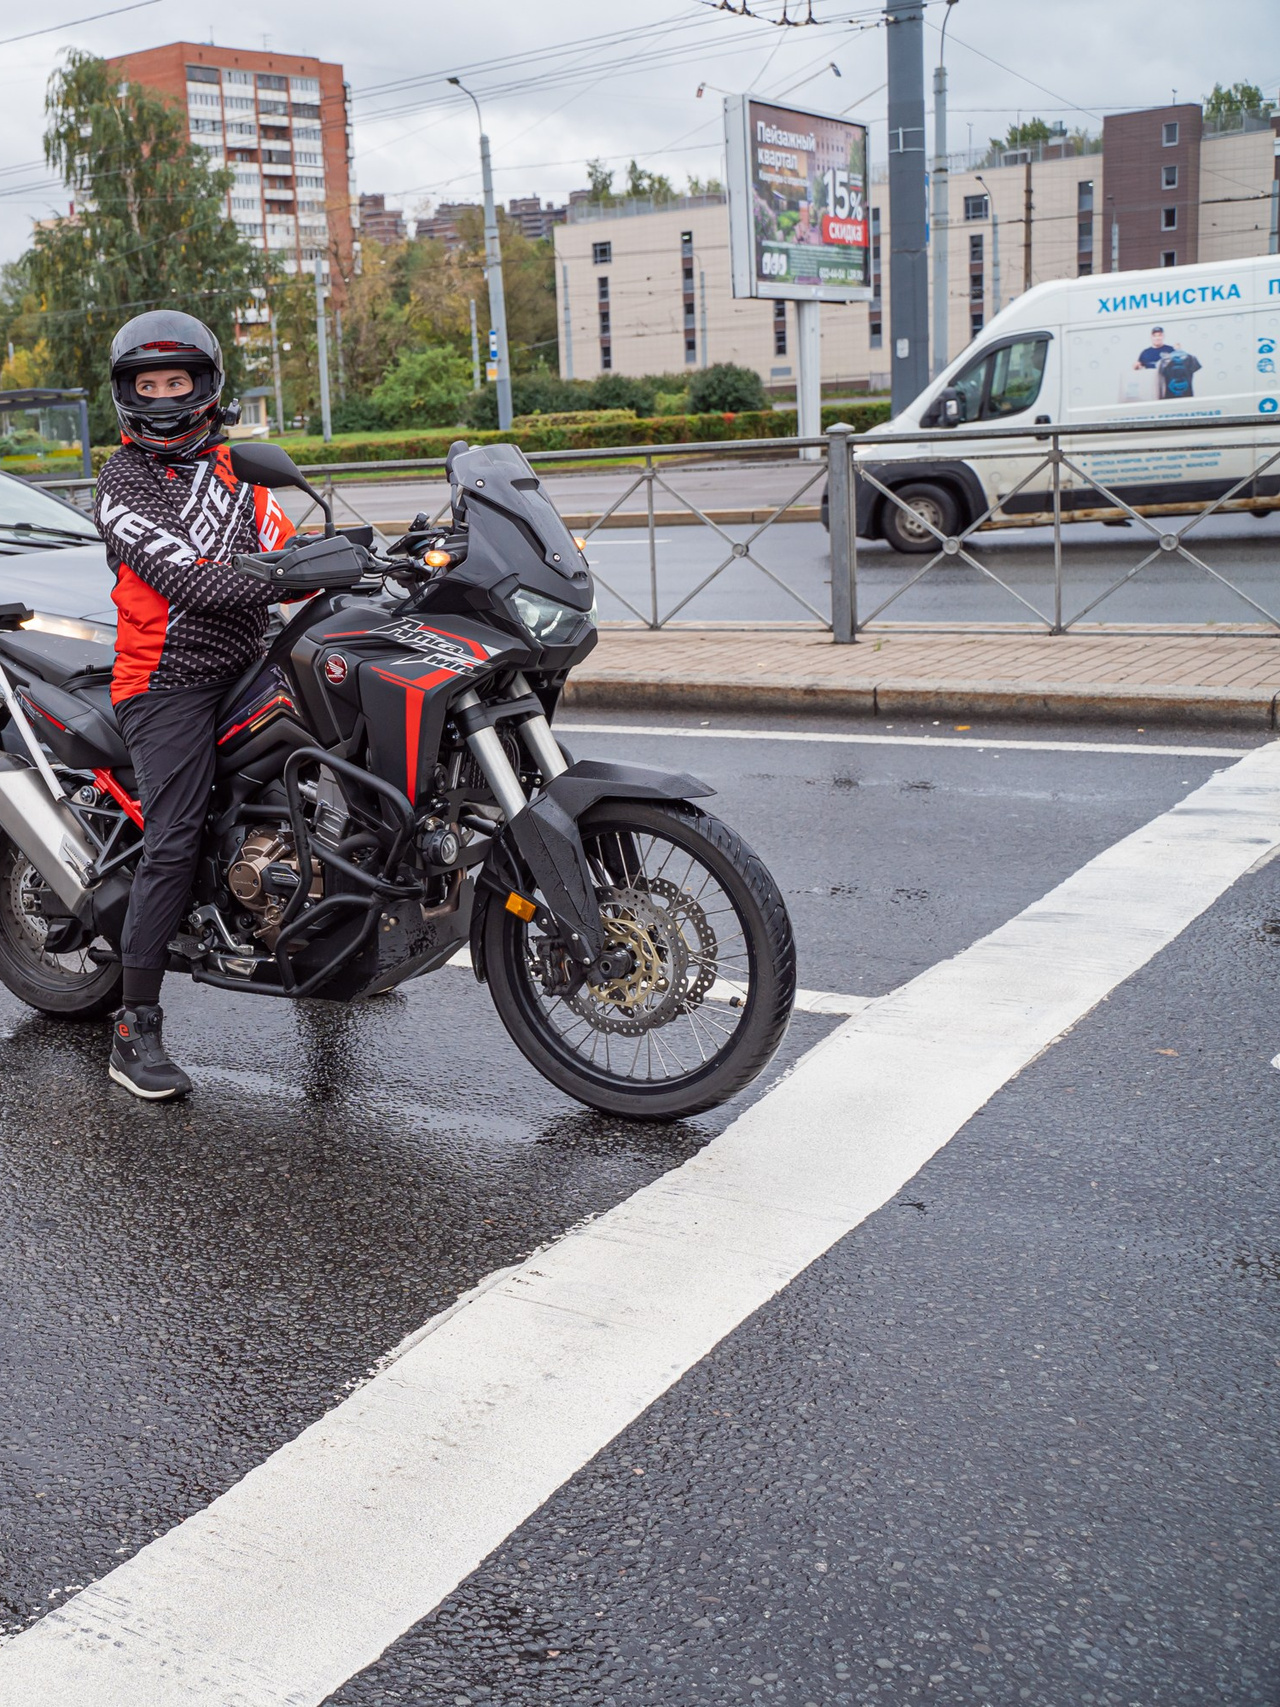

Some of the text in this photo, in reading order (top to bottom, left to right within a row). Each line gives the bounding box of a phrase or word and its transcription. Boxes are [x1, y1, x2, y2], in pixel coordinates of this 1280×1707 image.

[757, 120, 816, 152] Пейзажный
[757, 148, 798, 172] квартал
[829, 222, 863, 244] скидка
[1097, 283, 1242, 314] ХИМЧИСТКА
